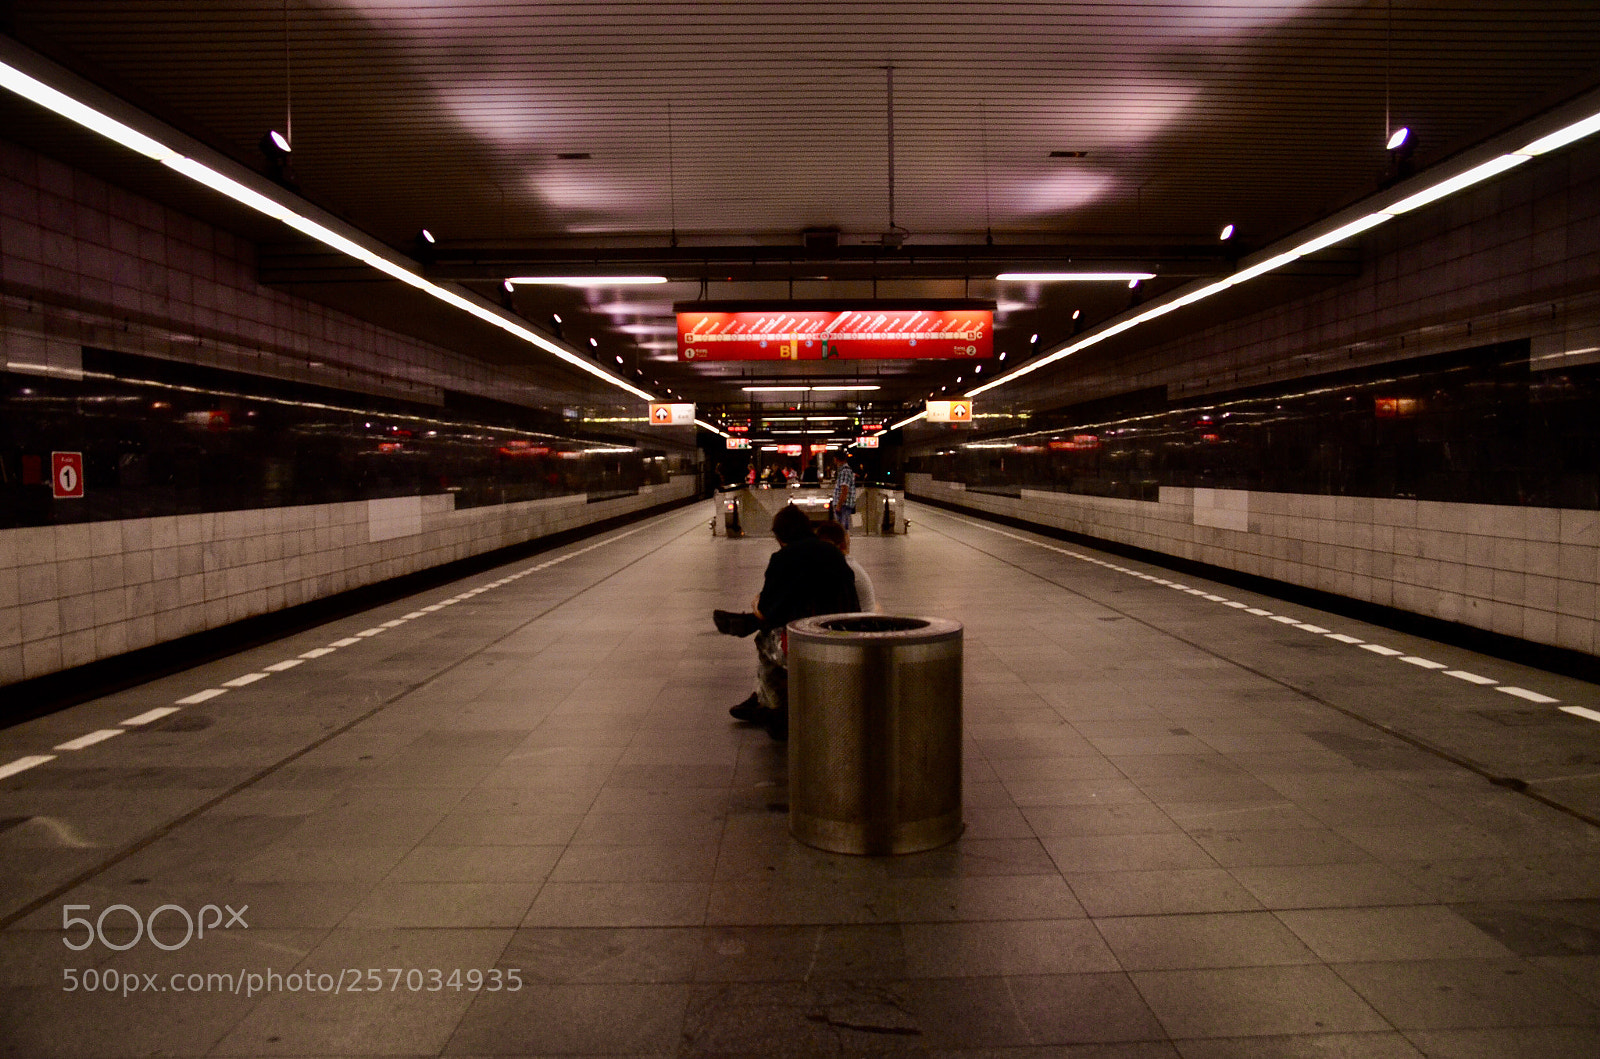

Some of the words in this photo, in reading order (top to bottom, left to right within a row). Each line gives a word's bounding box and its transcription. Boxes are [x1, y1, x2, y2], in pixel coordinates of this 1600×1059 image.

[780, 345, 790, 357] B
[829, 345, 838, 356] A
[64, 469, 70, 487] 1
